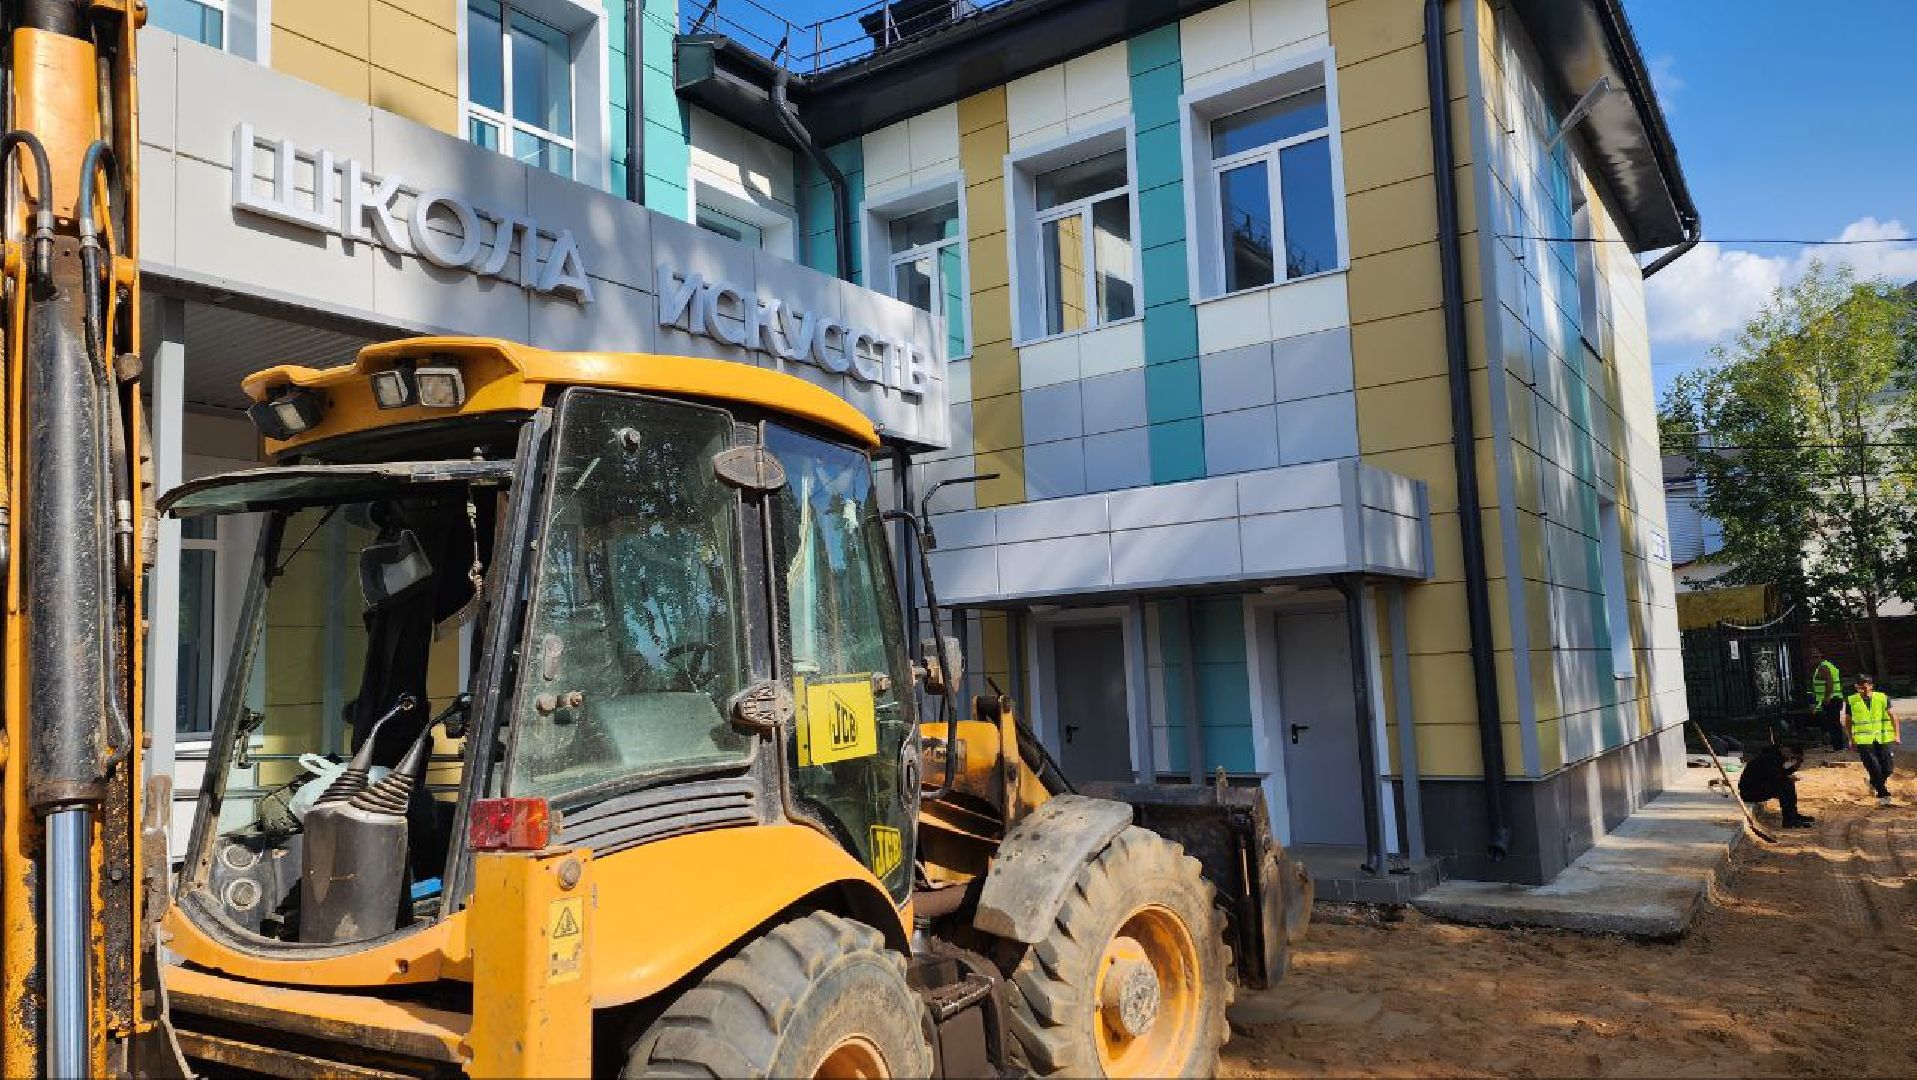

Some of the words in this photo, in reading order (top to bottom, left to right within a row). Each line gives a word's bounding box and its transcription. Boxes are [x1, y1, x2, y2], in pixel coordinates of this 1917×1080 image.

[232, 121, 594, 302] ШКОЛА
[658, 265, 930, 394] ИСКУССТВ
[831, 700, 857, 745] JCB
[875, 831, 900, 877] JCB
